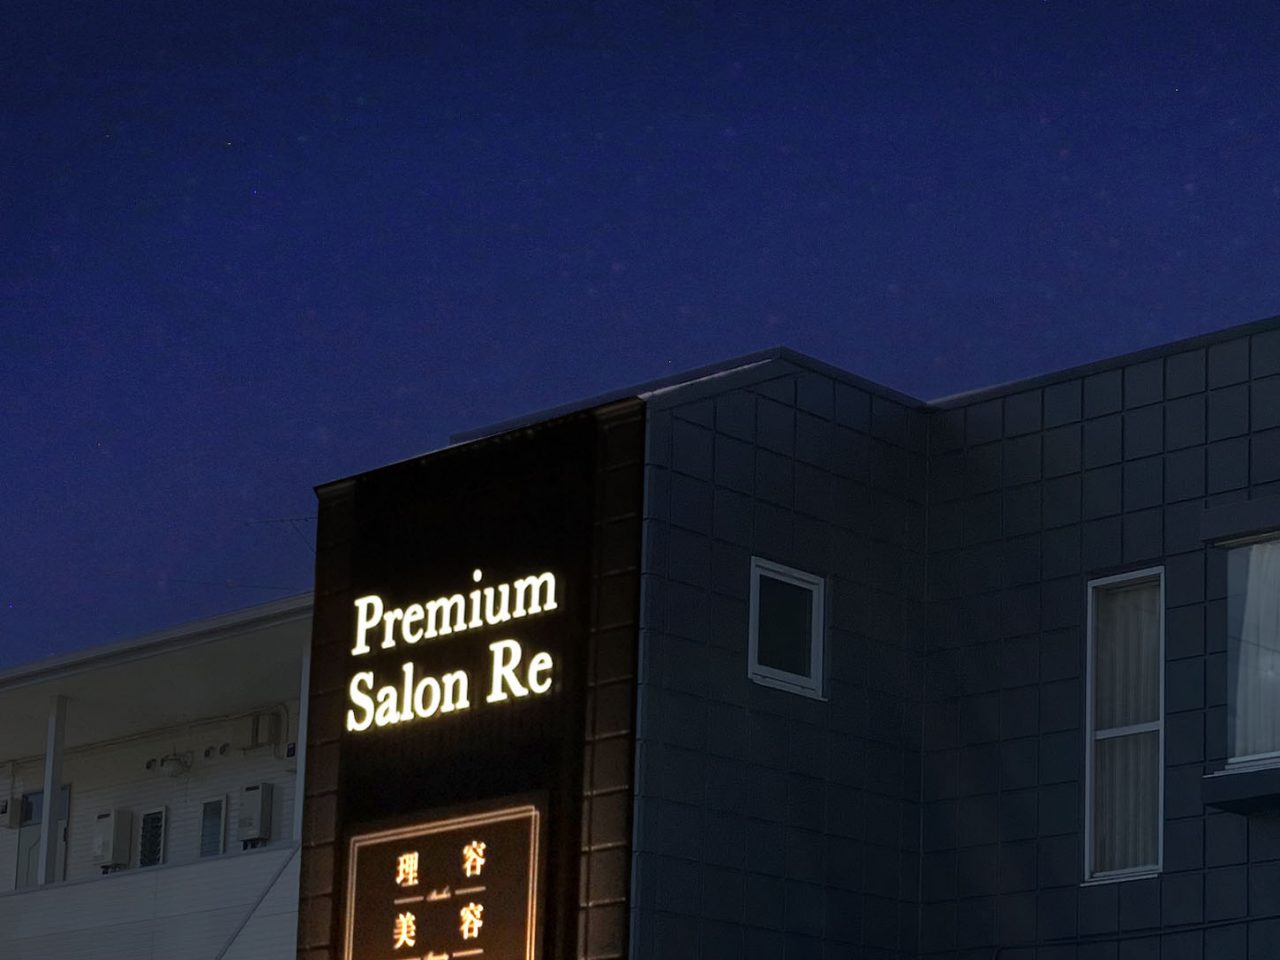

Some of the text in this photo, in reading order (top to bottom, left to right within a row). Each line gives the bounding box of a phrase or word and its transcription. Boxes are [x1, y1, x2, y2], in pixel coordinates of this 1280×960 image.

[351, 568, 558, 656] Premium
[346, 638, 554, 732] Salon Re
[395, 840, 487, 887] 理容
[393, 902, 484, 949] 美容
